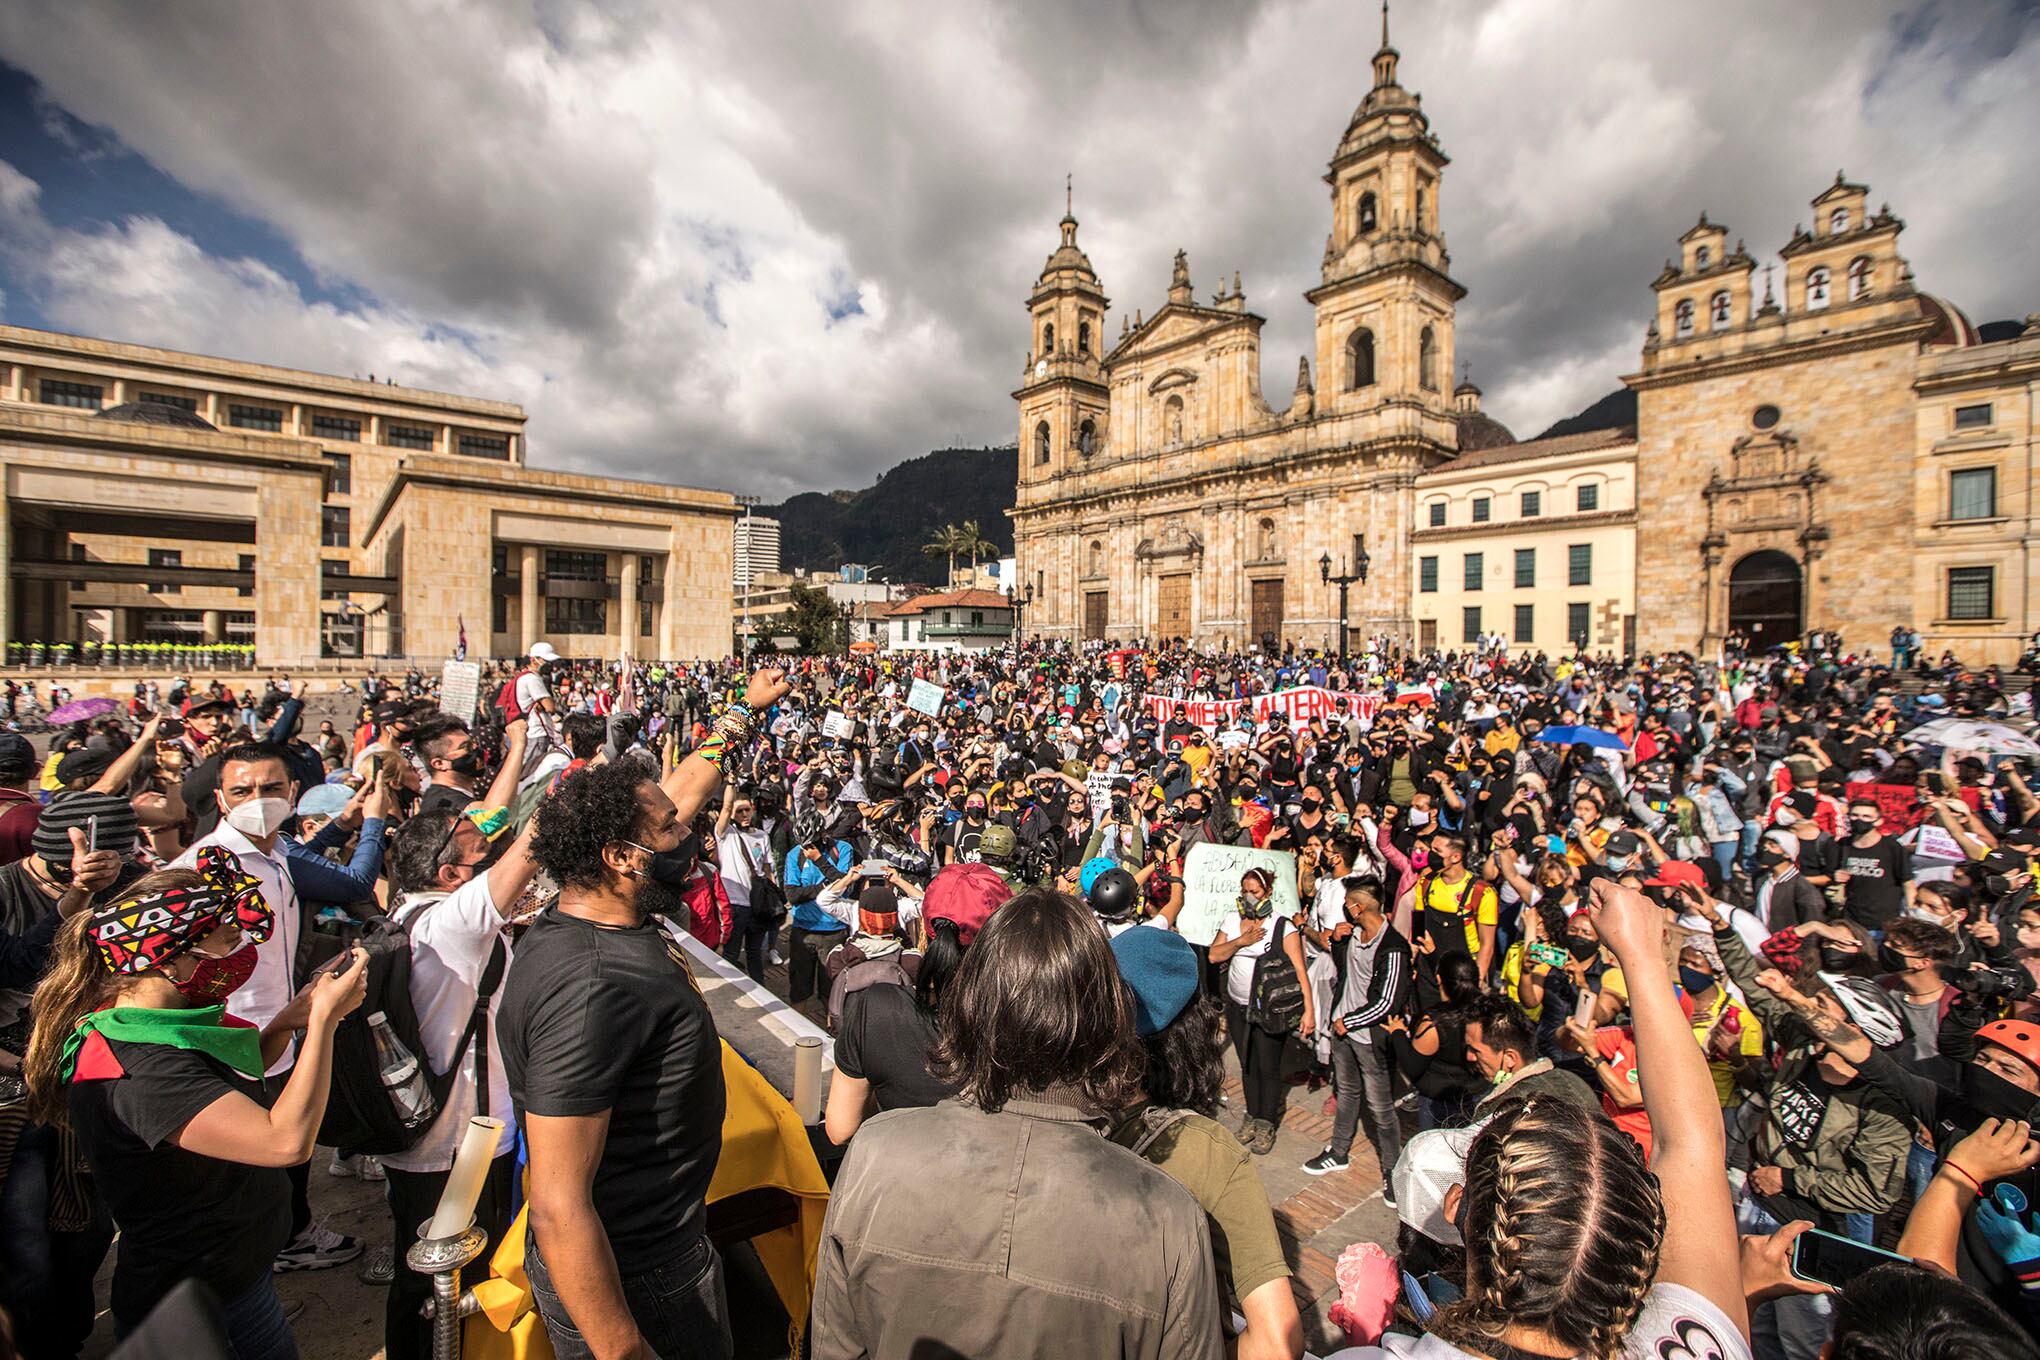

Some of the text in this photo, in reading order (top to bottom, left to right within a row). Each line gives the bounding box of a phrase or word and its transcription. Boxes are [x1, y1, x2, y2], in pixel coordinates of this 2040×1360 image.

[1144, 690, 1381, 726] MOVMIENT ALTERNTIV
[1210, 876, 1240, 893] FUERZ
